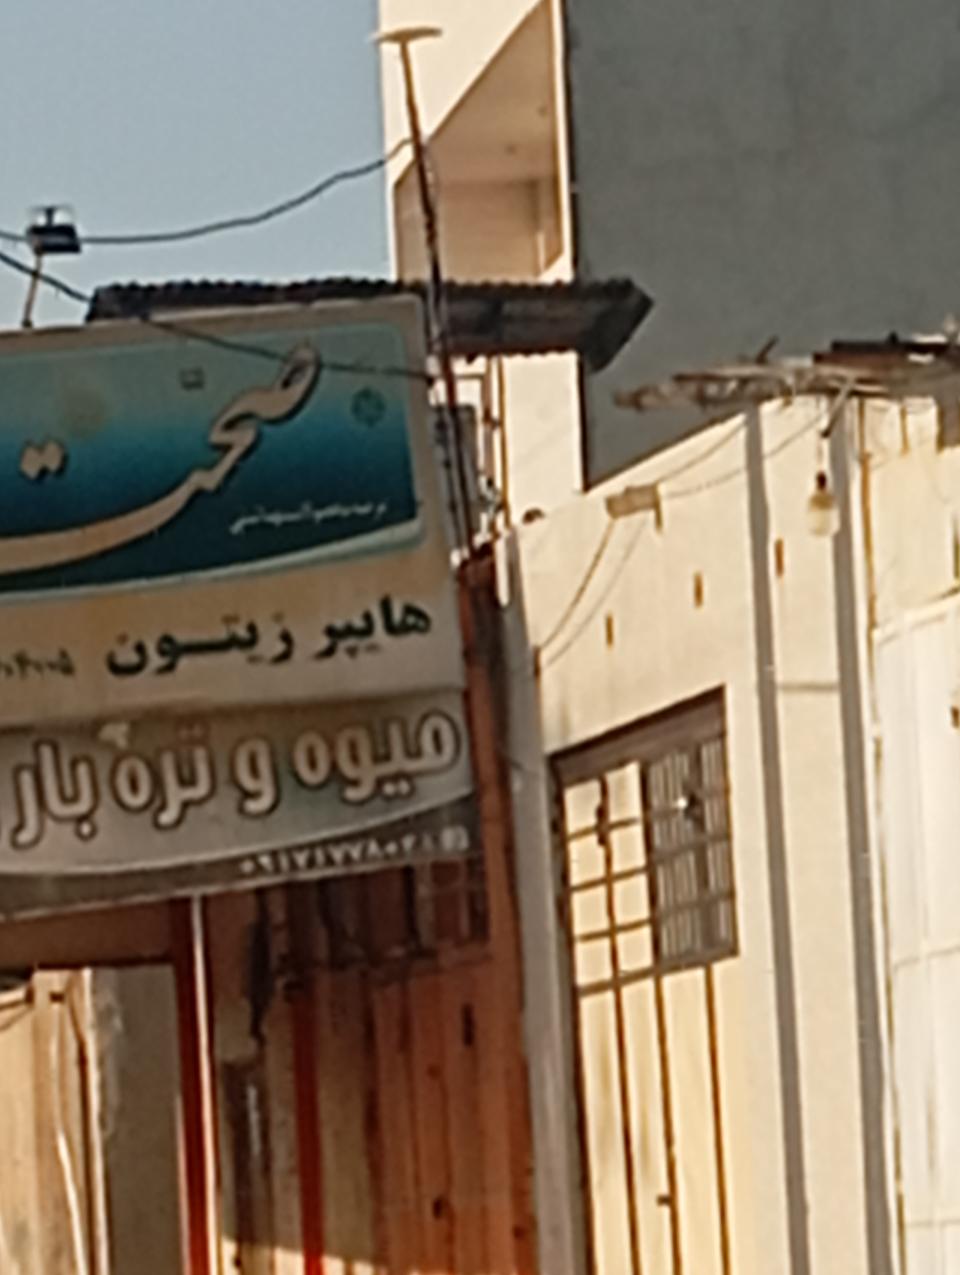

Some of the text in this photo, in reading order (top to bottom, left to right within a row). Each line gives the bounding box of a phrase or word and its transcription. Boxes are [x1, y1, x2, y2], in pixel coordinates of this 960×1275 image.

[106, 612, 295, 677] زیتون
[315, 594, 432, 660] هایپر
[9, 738, 97, 849] بار
[232, 734, 281, 818] و
[293, 706, 460, 805] میوه
